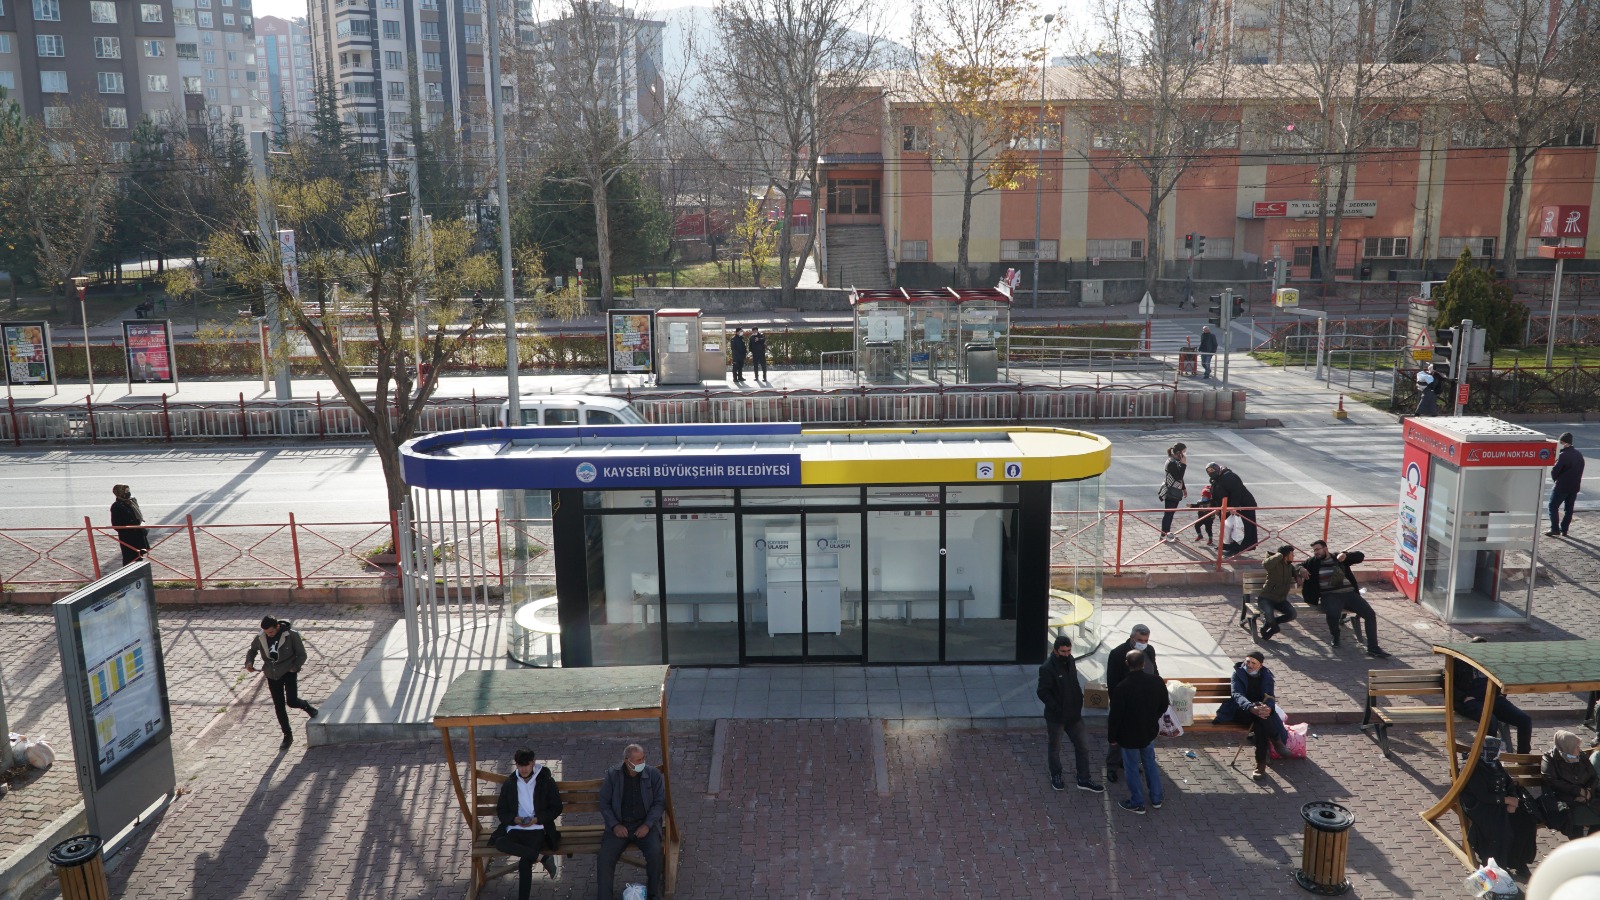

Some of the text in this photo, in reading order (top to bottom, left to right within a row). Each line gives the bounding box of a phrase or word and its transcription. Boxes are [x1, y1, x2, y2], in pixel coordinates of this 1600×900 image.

[1507, 450, 1536, 458] NOKTASI
[603, 462, 790, 479] KAYSERİ BÜYÜKŞEHİR BELEDİYESİ
